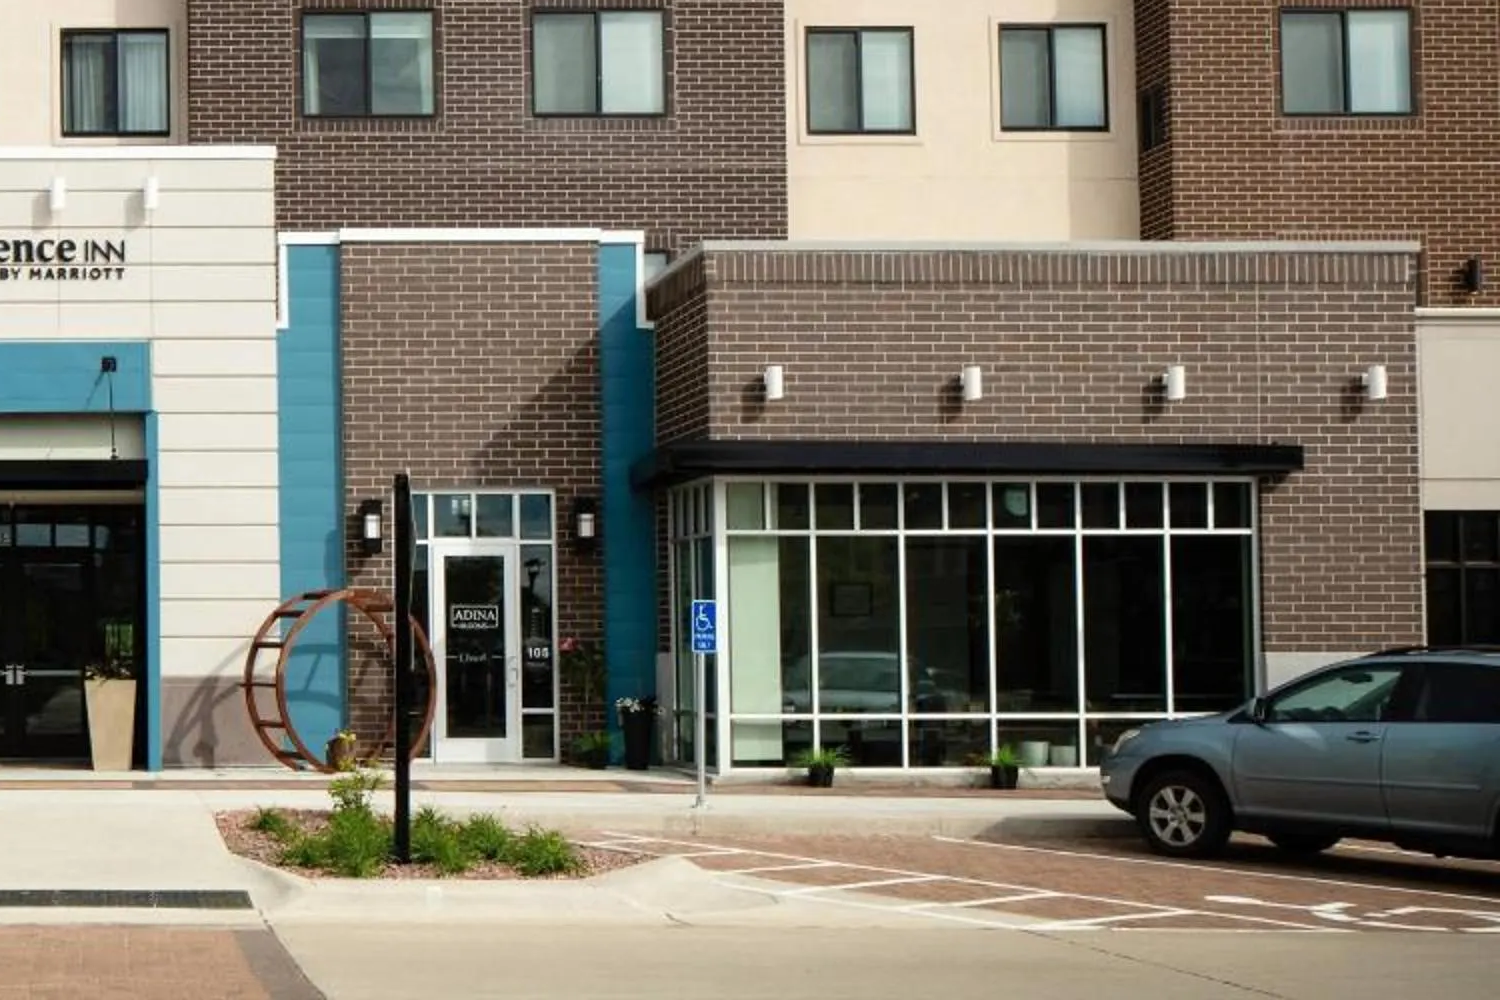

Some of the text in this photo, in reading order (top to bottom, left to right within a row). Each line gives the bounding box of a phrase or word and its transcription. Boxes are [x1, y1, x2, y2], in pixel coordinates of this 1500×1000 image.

[84, 240, 125, 262] INN
[0, 267, 125, 280] BY MARRIOTT
[454, 609, 495, 621] ADINA
